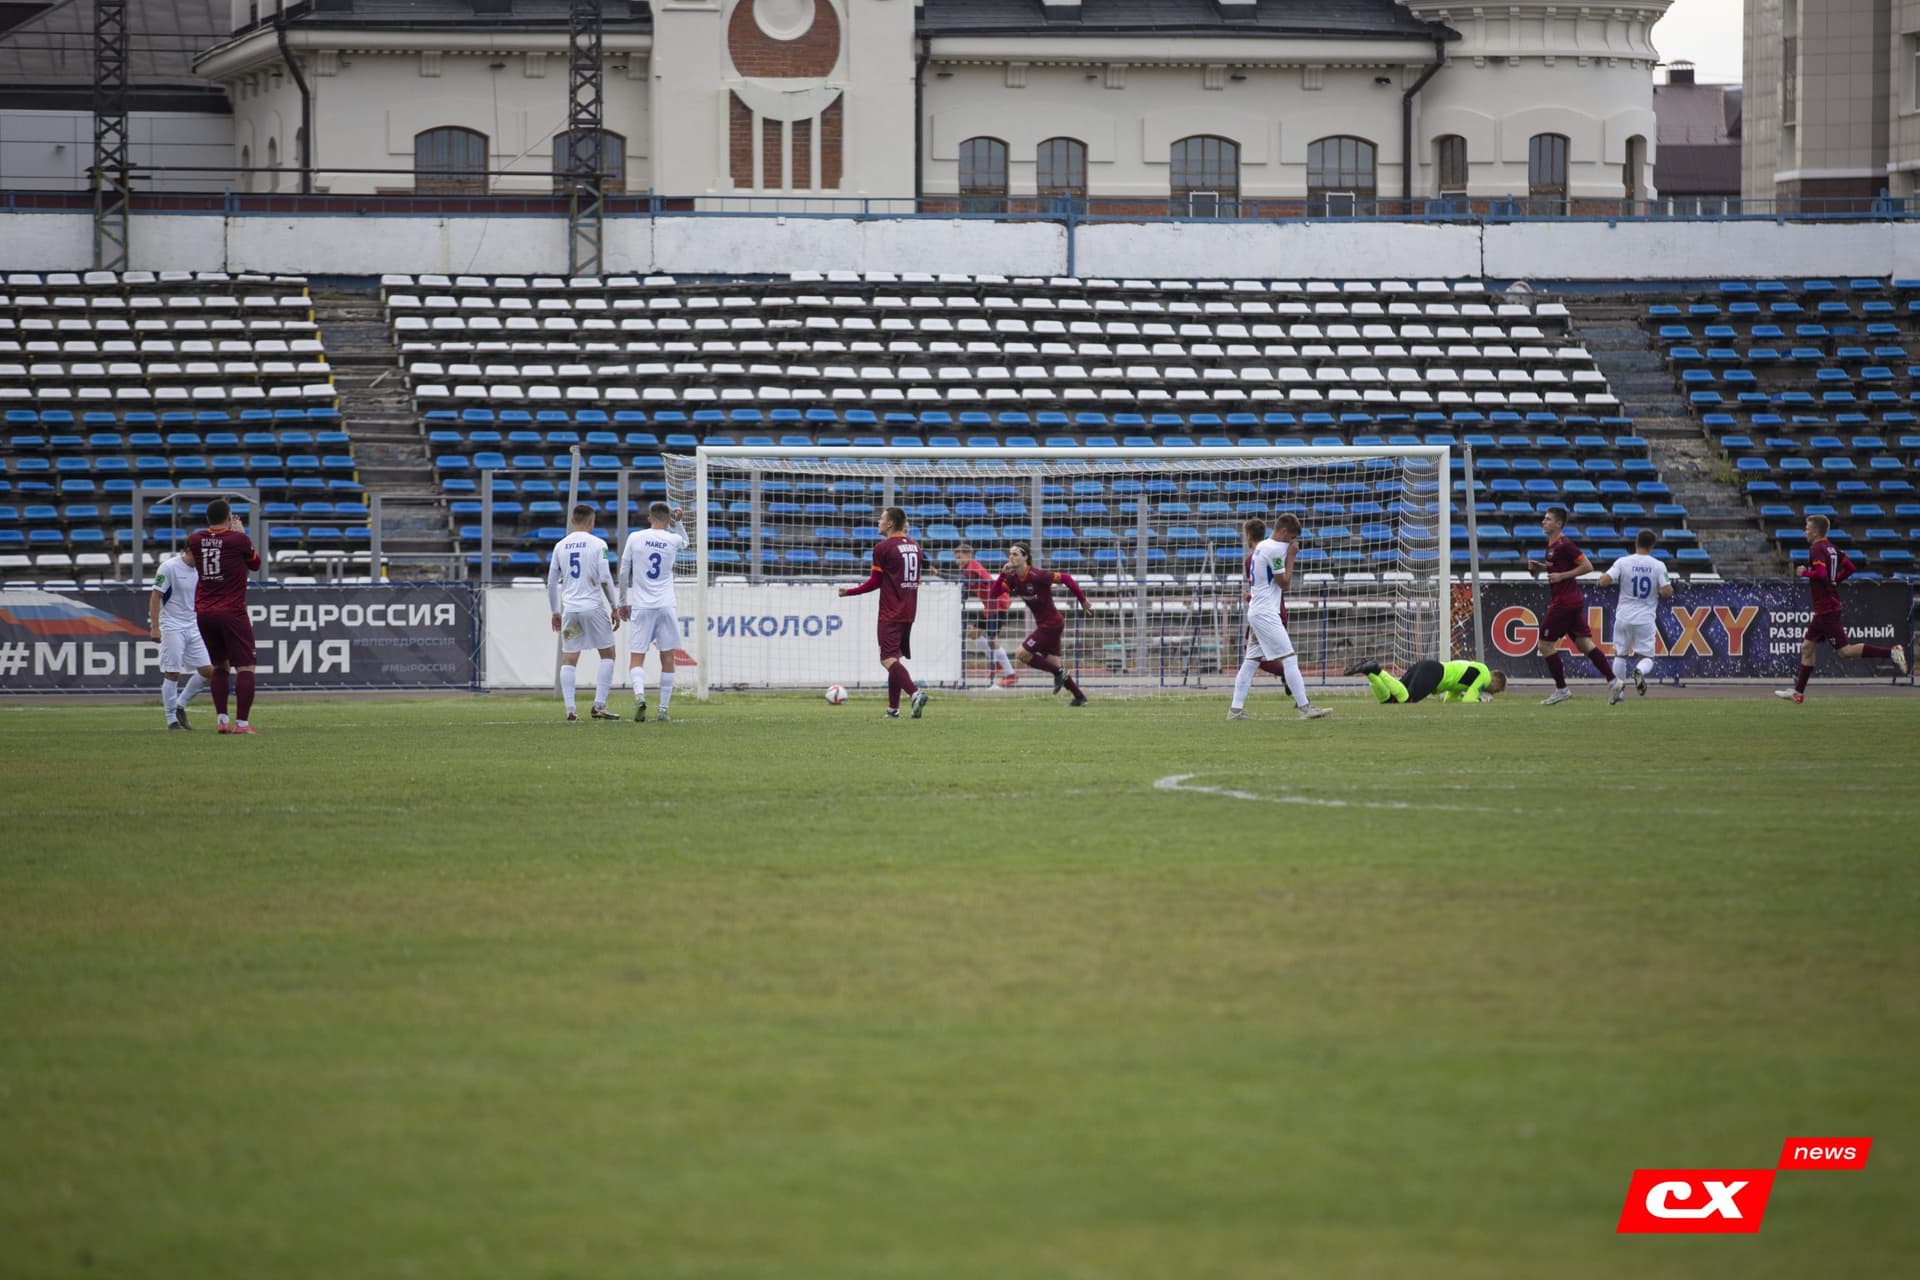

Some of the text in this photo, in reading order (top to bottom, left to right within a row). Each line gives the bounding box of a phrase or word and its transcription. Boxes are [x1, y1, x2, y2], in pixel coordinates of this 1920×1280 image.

[201, 548, 221, 575] 13
[570, 552, 580, 579] 5
[646, 552, 662, 579] 3
[902, 552, 919, 582] 19
[1631, 575, 1652, 599] 19
[147, 603, 456, 632] РЕДРОССИЯ
[0, 640, 350, 676] #МЫРИЯ
[1769, 643, 1802, 655] ЦЕНТ
[381, 663, 457, 673] #МЫРОССИЯ
